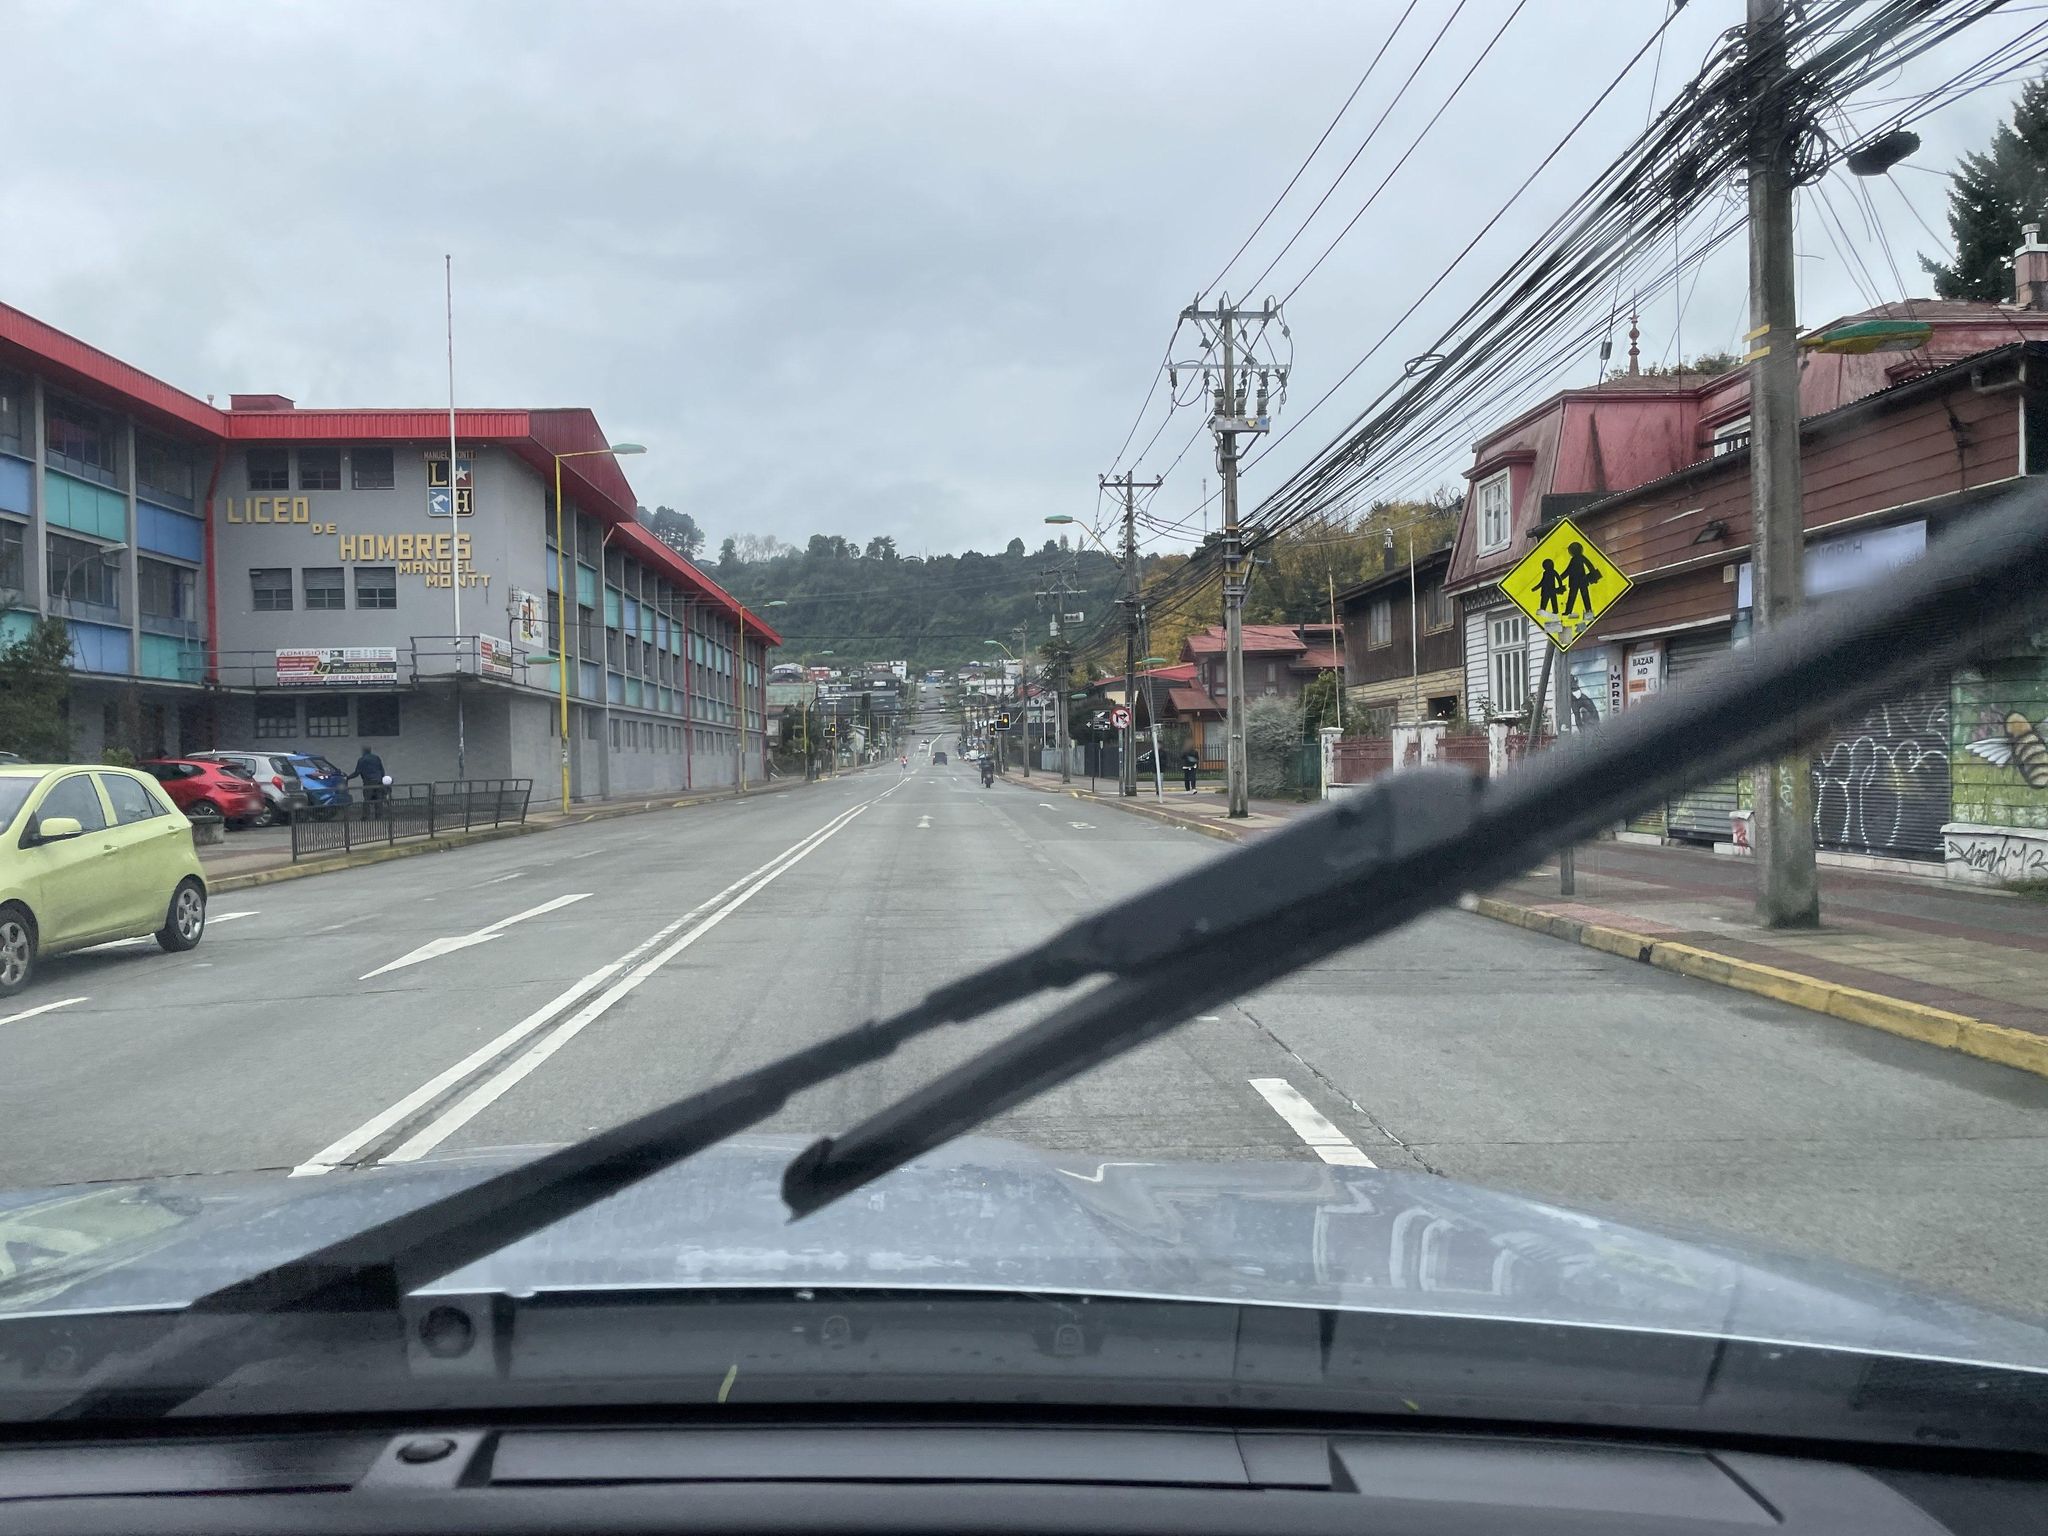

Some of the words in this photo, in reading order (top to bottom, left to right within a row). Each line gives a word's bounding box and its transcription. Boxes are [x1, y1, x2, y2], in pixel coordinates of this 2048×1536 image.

[430, 462, 448, 486] L
[227, 495, 310, 523] LICEO
[455, 490, 470, 513] H
[312, 522, 337, 535] DE
[340, 533, 472, 561] HOMBRES
[398, 560, 477, 574] MANUEL
[1632, 656, 1654, 667] BAZAR
